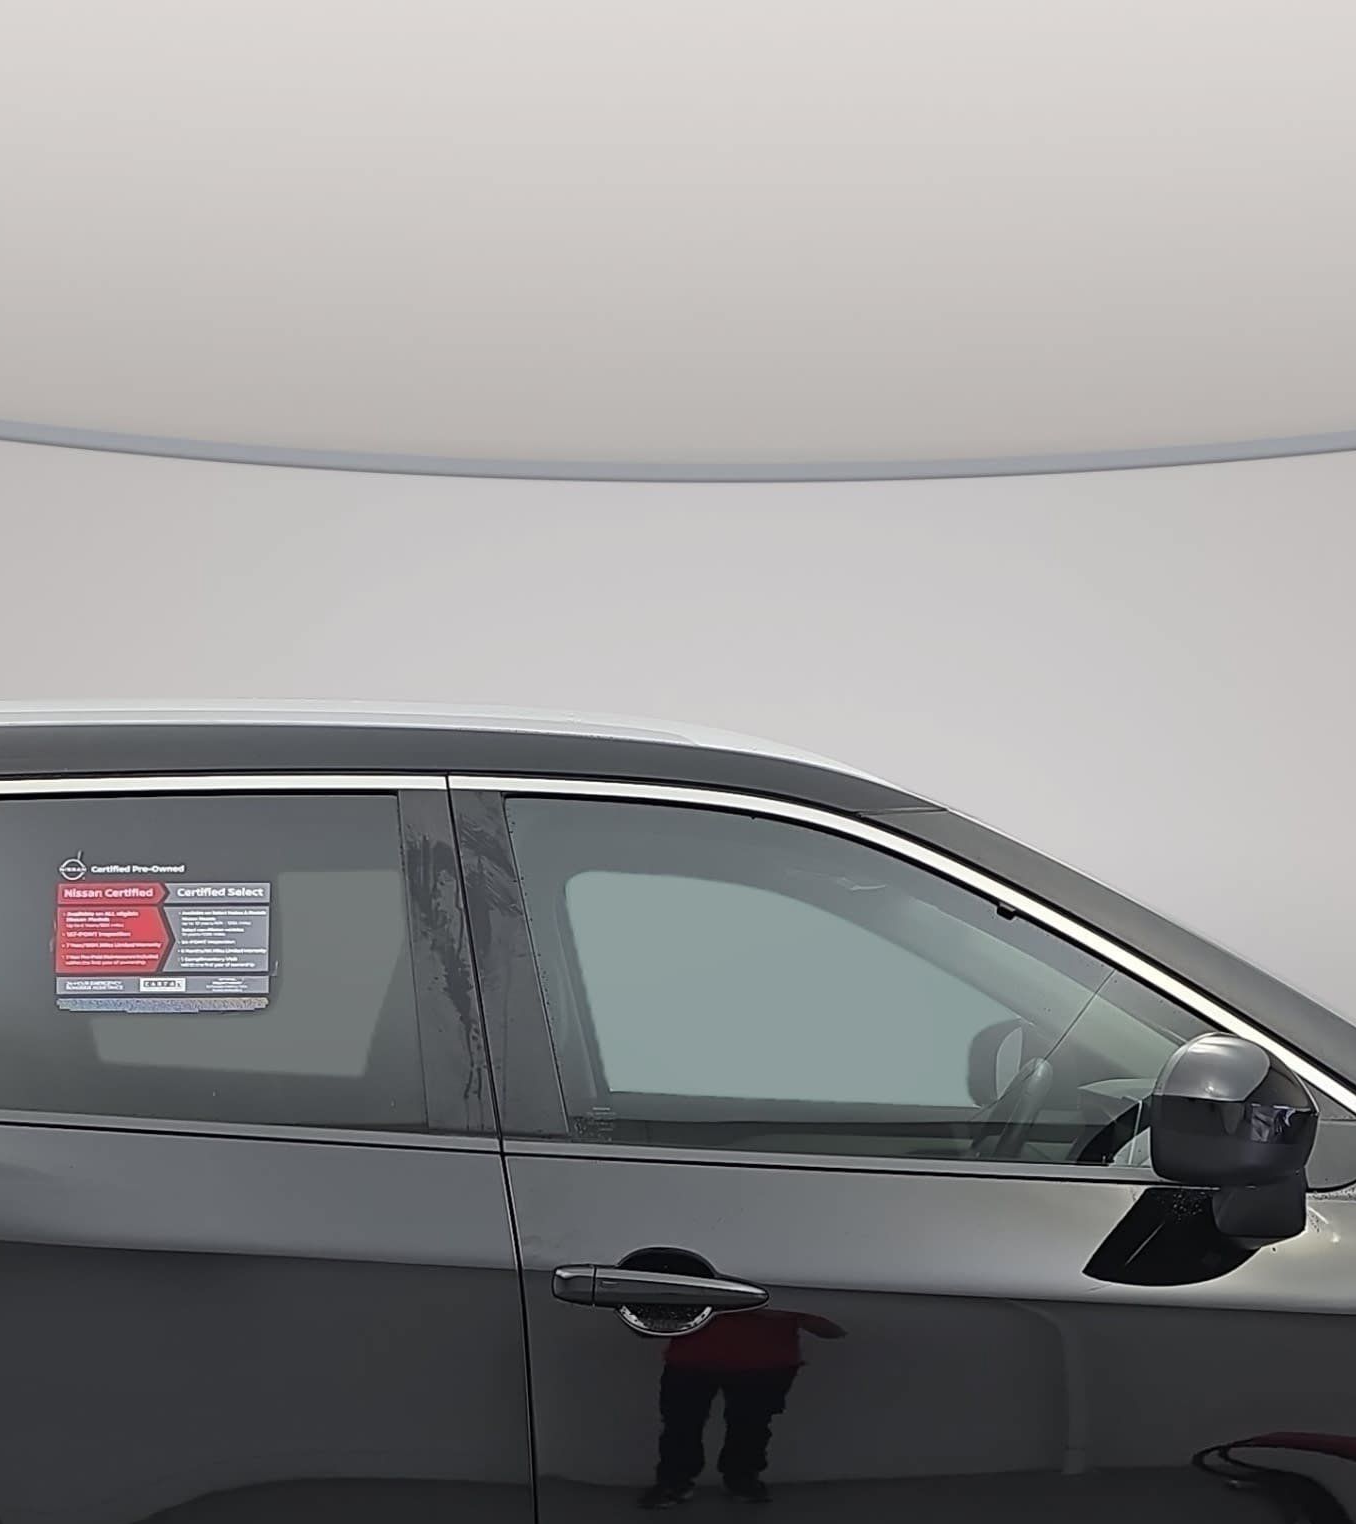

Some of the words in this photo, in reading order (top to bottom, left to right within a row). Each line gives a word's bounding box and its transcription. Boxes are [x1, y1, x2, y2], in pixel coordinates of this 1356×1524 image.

[91, 864, 131, 874] Certified
[132, 864, 186, 874] Pre-Owned
[64, 888, 103, 898] Nissan
[104, 887, 154, 898] Certified
[177, 887, 226, 898] Certified
[227, 887, 264, 898] Select
